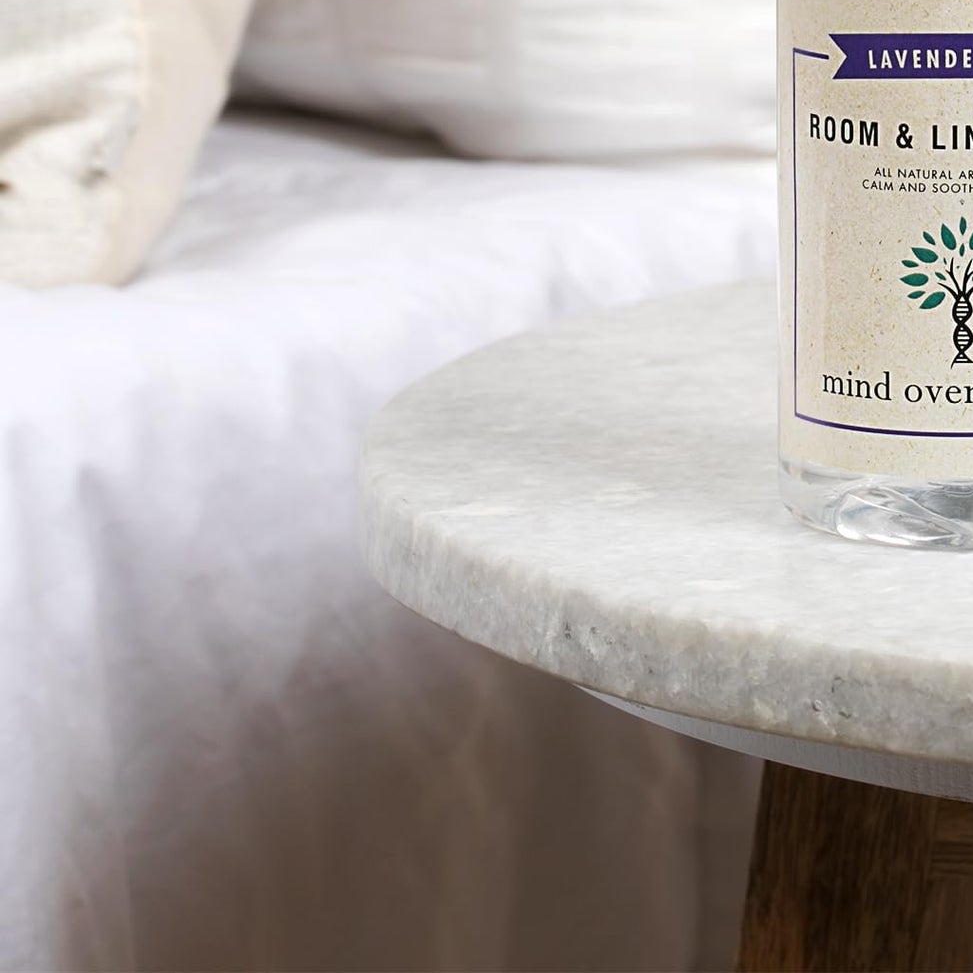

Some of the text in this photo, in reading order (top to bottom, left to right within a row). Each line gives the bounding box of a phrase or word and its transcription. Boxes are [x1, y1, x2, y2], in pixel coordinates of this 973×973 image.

[809, 113, 879, 147] ROOM
[896, 123, 914, 149] &
[874, 167, 892, 178] ALL
[897, 168, 953, 180] NATURAL
[862, 179, 894, 191] CALM
[899, 182, 926, 193] AND
[822, 370, 892, 402] mind
